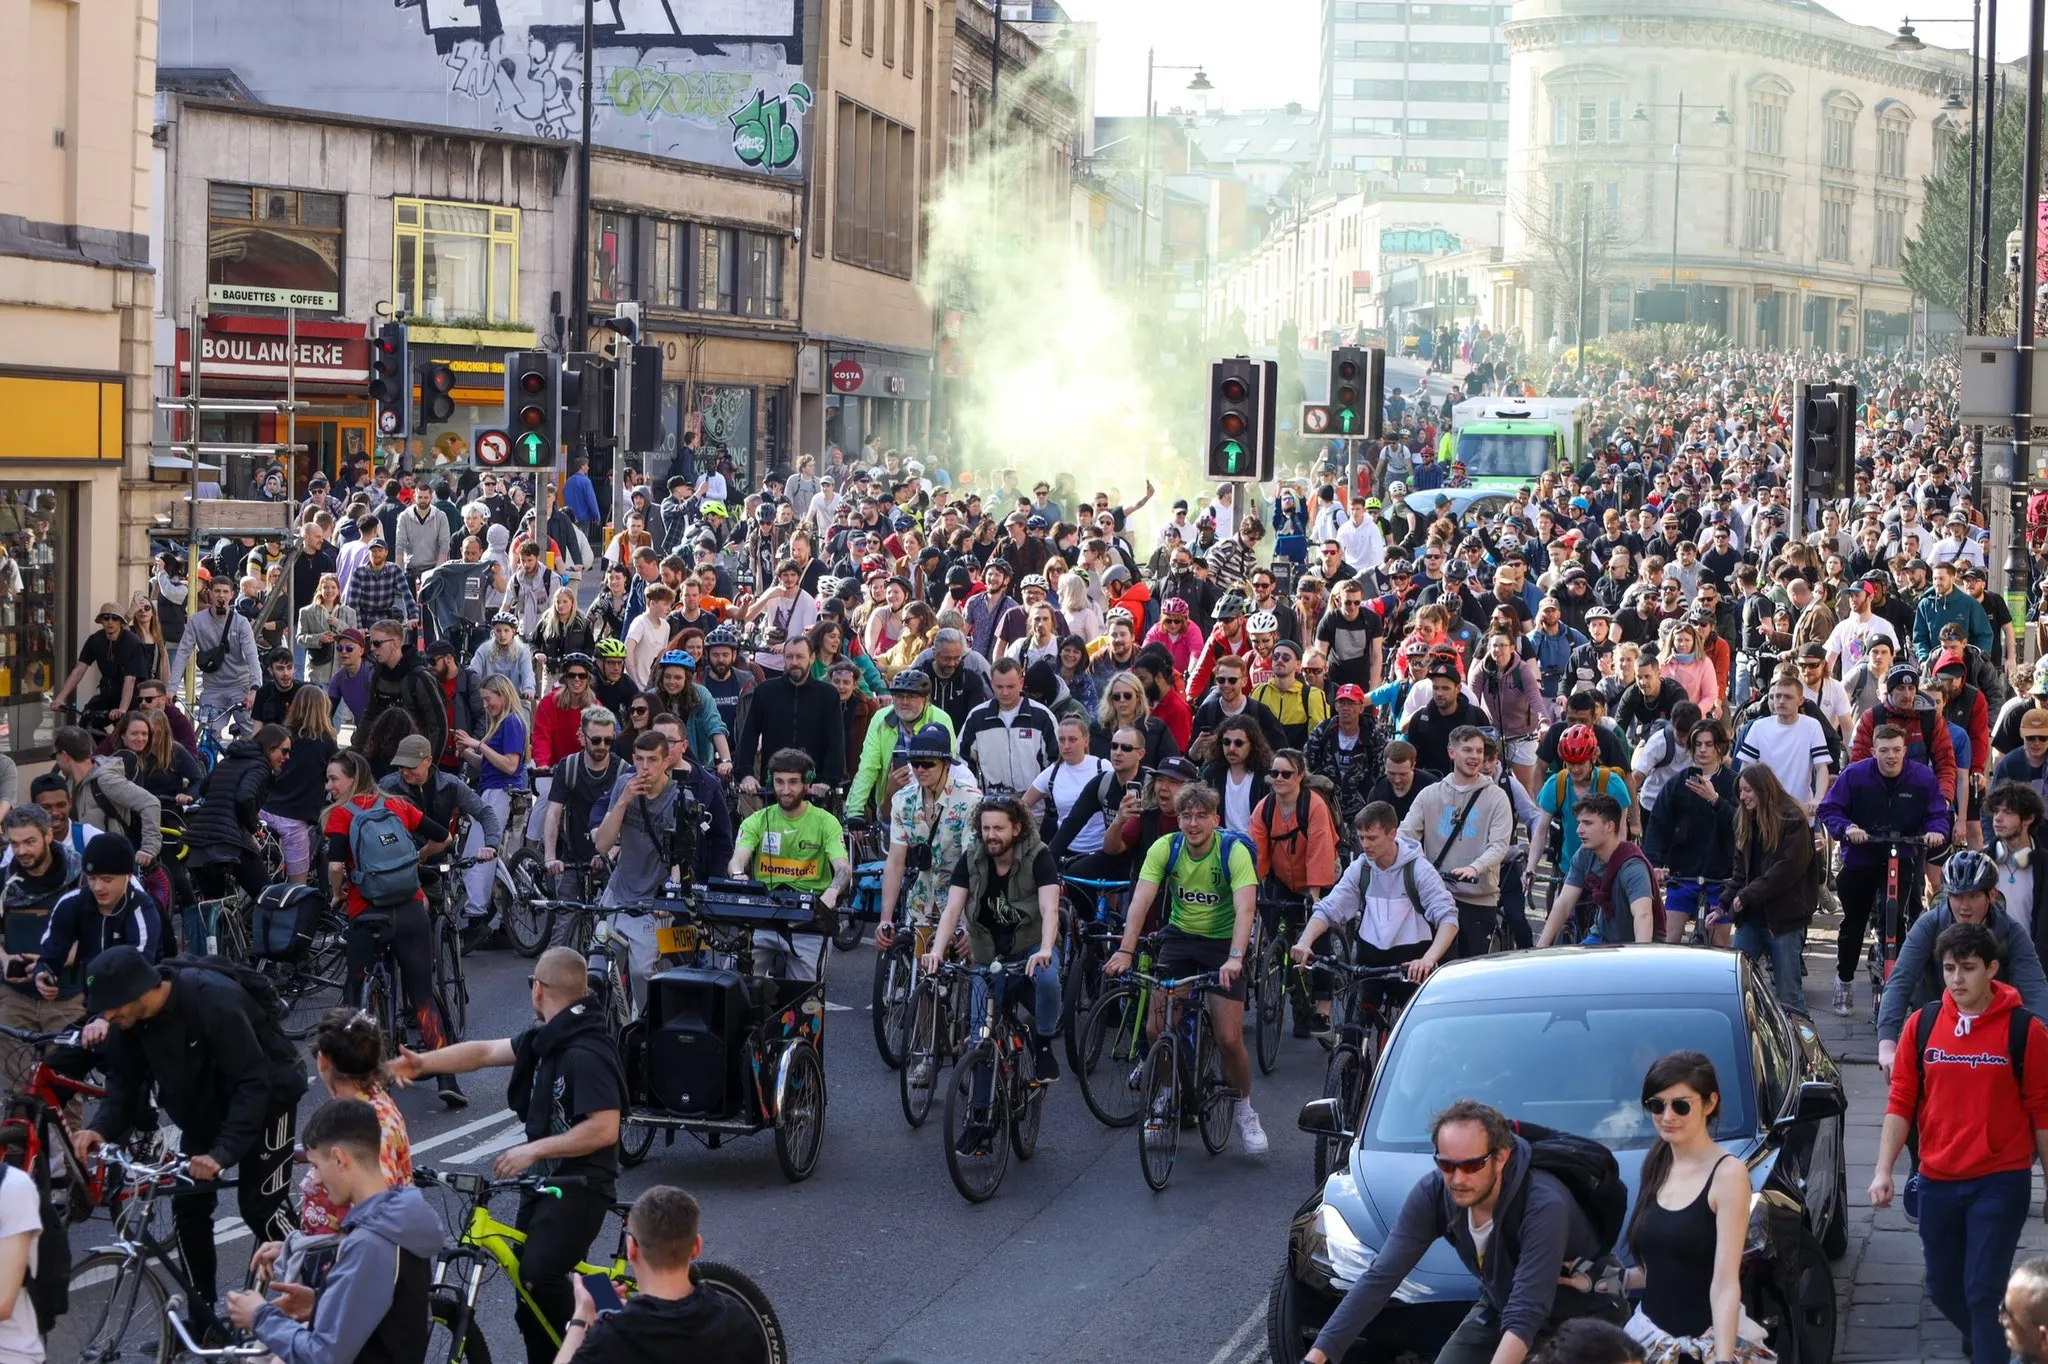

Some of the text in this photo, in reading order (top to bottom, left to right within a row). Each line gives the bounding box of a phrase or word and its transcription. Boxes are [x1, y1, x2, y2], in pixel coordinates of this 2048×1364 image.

[222, 289, 324, 306] BAGUETTES COFFEE
[834, 370, 861, 381] COSTA
[891, 375, 906, 394] COSTA
[760, 861, 809, 878] homestar
[1177, 886, 1221, 905] Jeep
[1923, 1047, 2009, 1068] Champion
